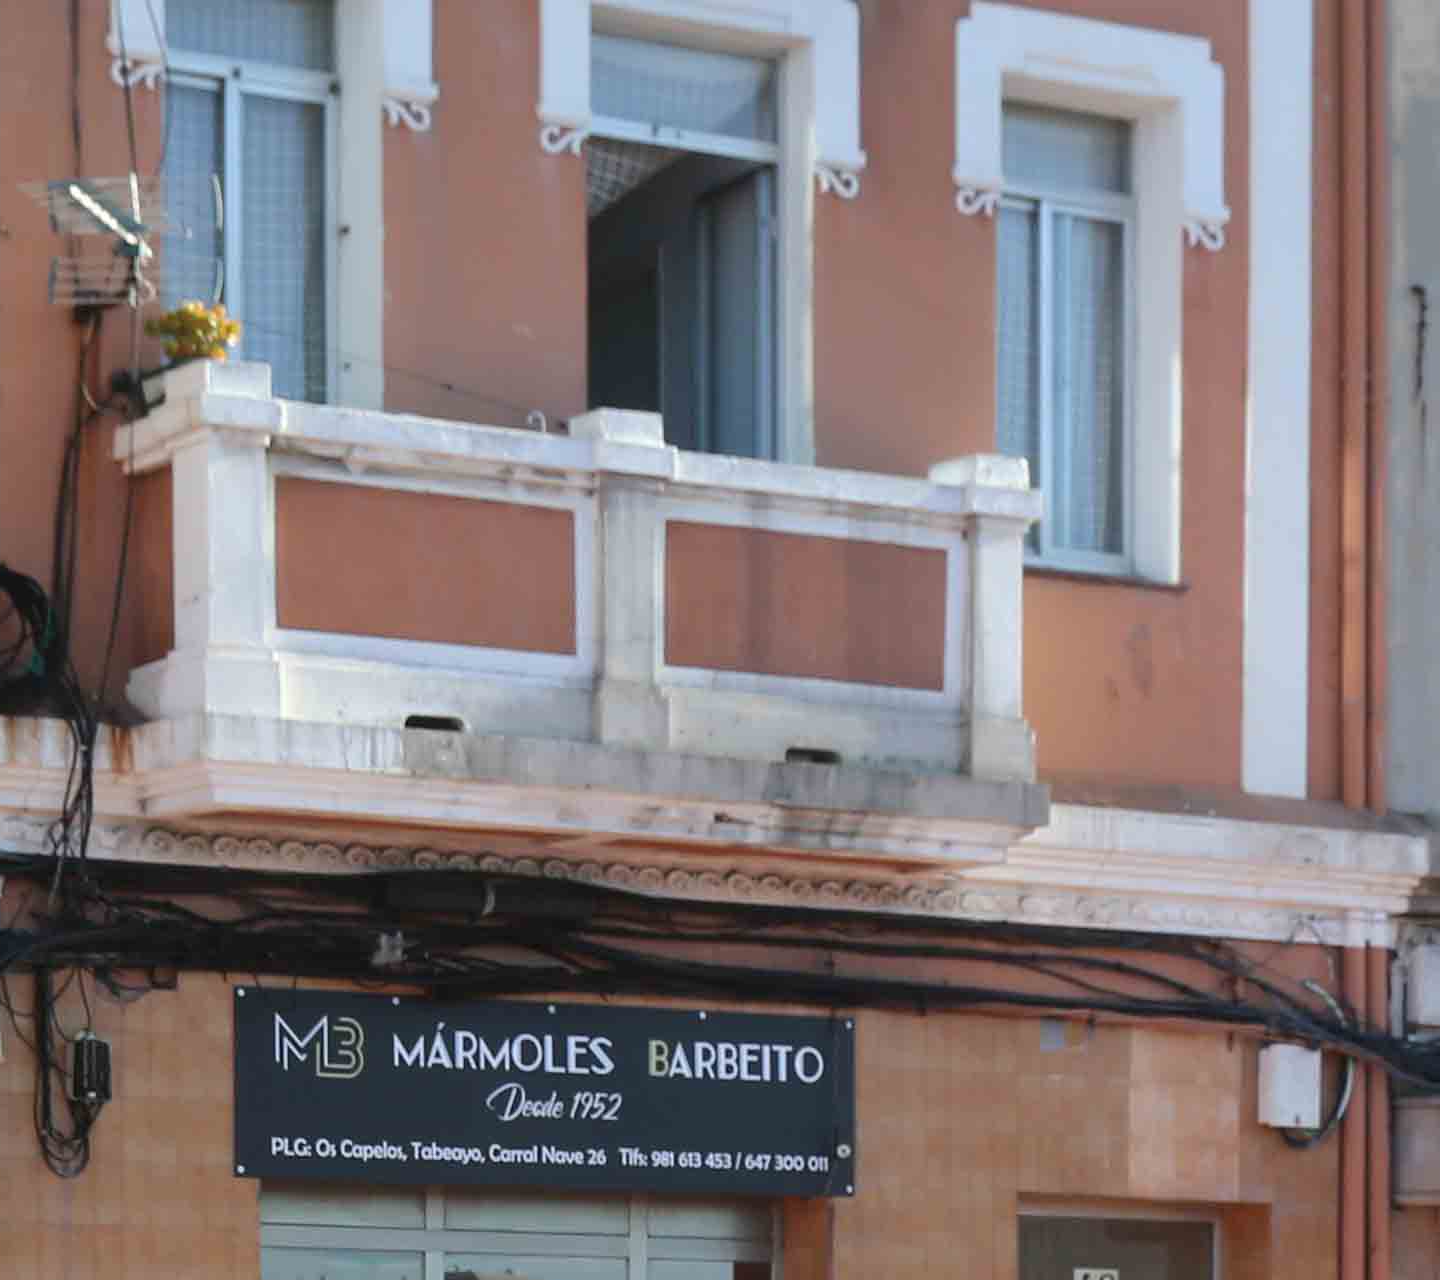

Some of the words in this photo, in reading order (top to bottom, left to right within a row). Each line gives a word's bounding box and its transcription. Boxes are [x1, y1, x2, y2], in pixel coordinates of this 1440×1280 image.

[392, 1022, 616, 1074] MÁRMOLES
[648, 1038, 824, 1084] BARBEITO
[486, 1082, 564, 1121] Desde
[570, 1091, 623, 1121] 1952
[271, 1137, 312, 1157] PLG:
[316, 1138, 337, 1158] Os
[340, 1139, 408, 1163] Capelos,
[411, 1141, 486, 1165] Tabeayo,
[489, 1144, 538, 1164] Carral
[541, 1146, 585, 1166] Nave
[587, 1149, 607, 1166] 26
[651, 1150, 675, 1168] 981
[678, 1151, 702, 1169] 613
[705, 1152, 733, 1170] 453
[744, 1153, 771, 1171] 647
[774, 1155, 805, 1172] 300
[807, 1155, 829, 1173] 011
